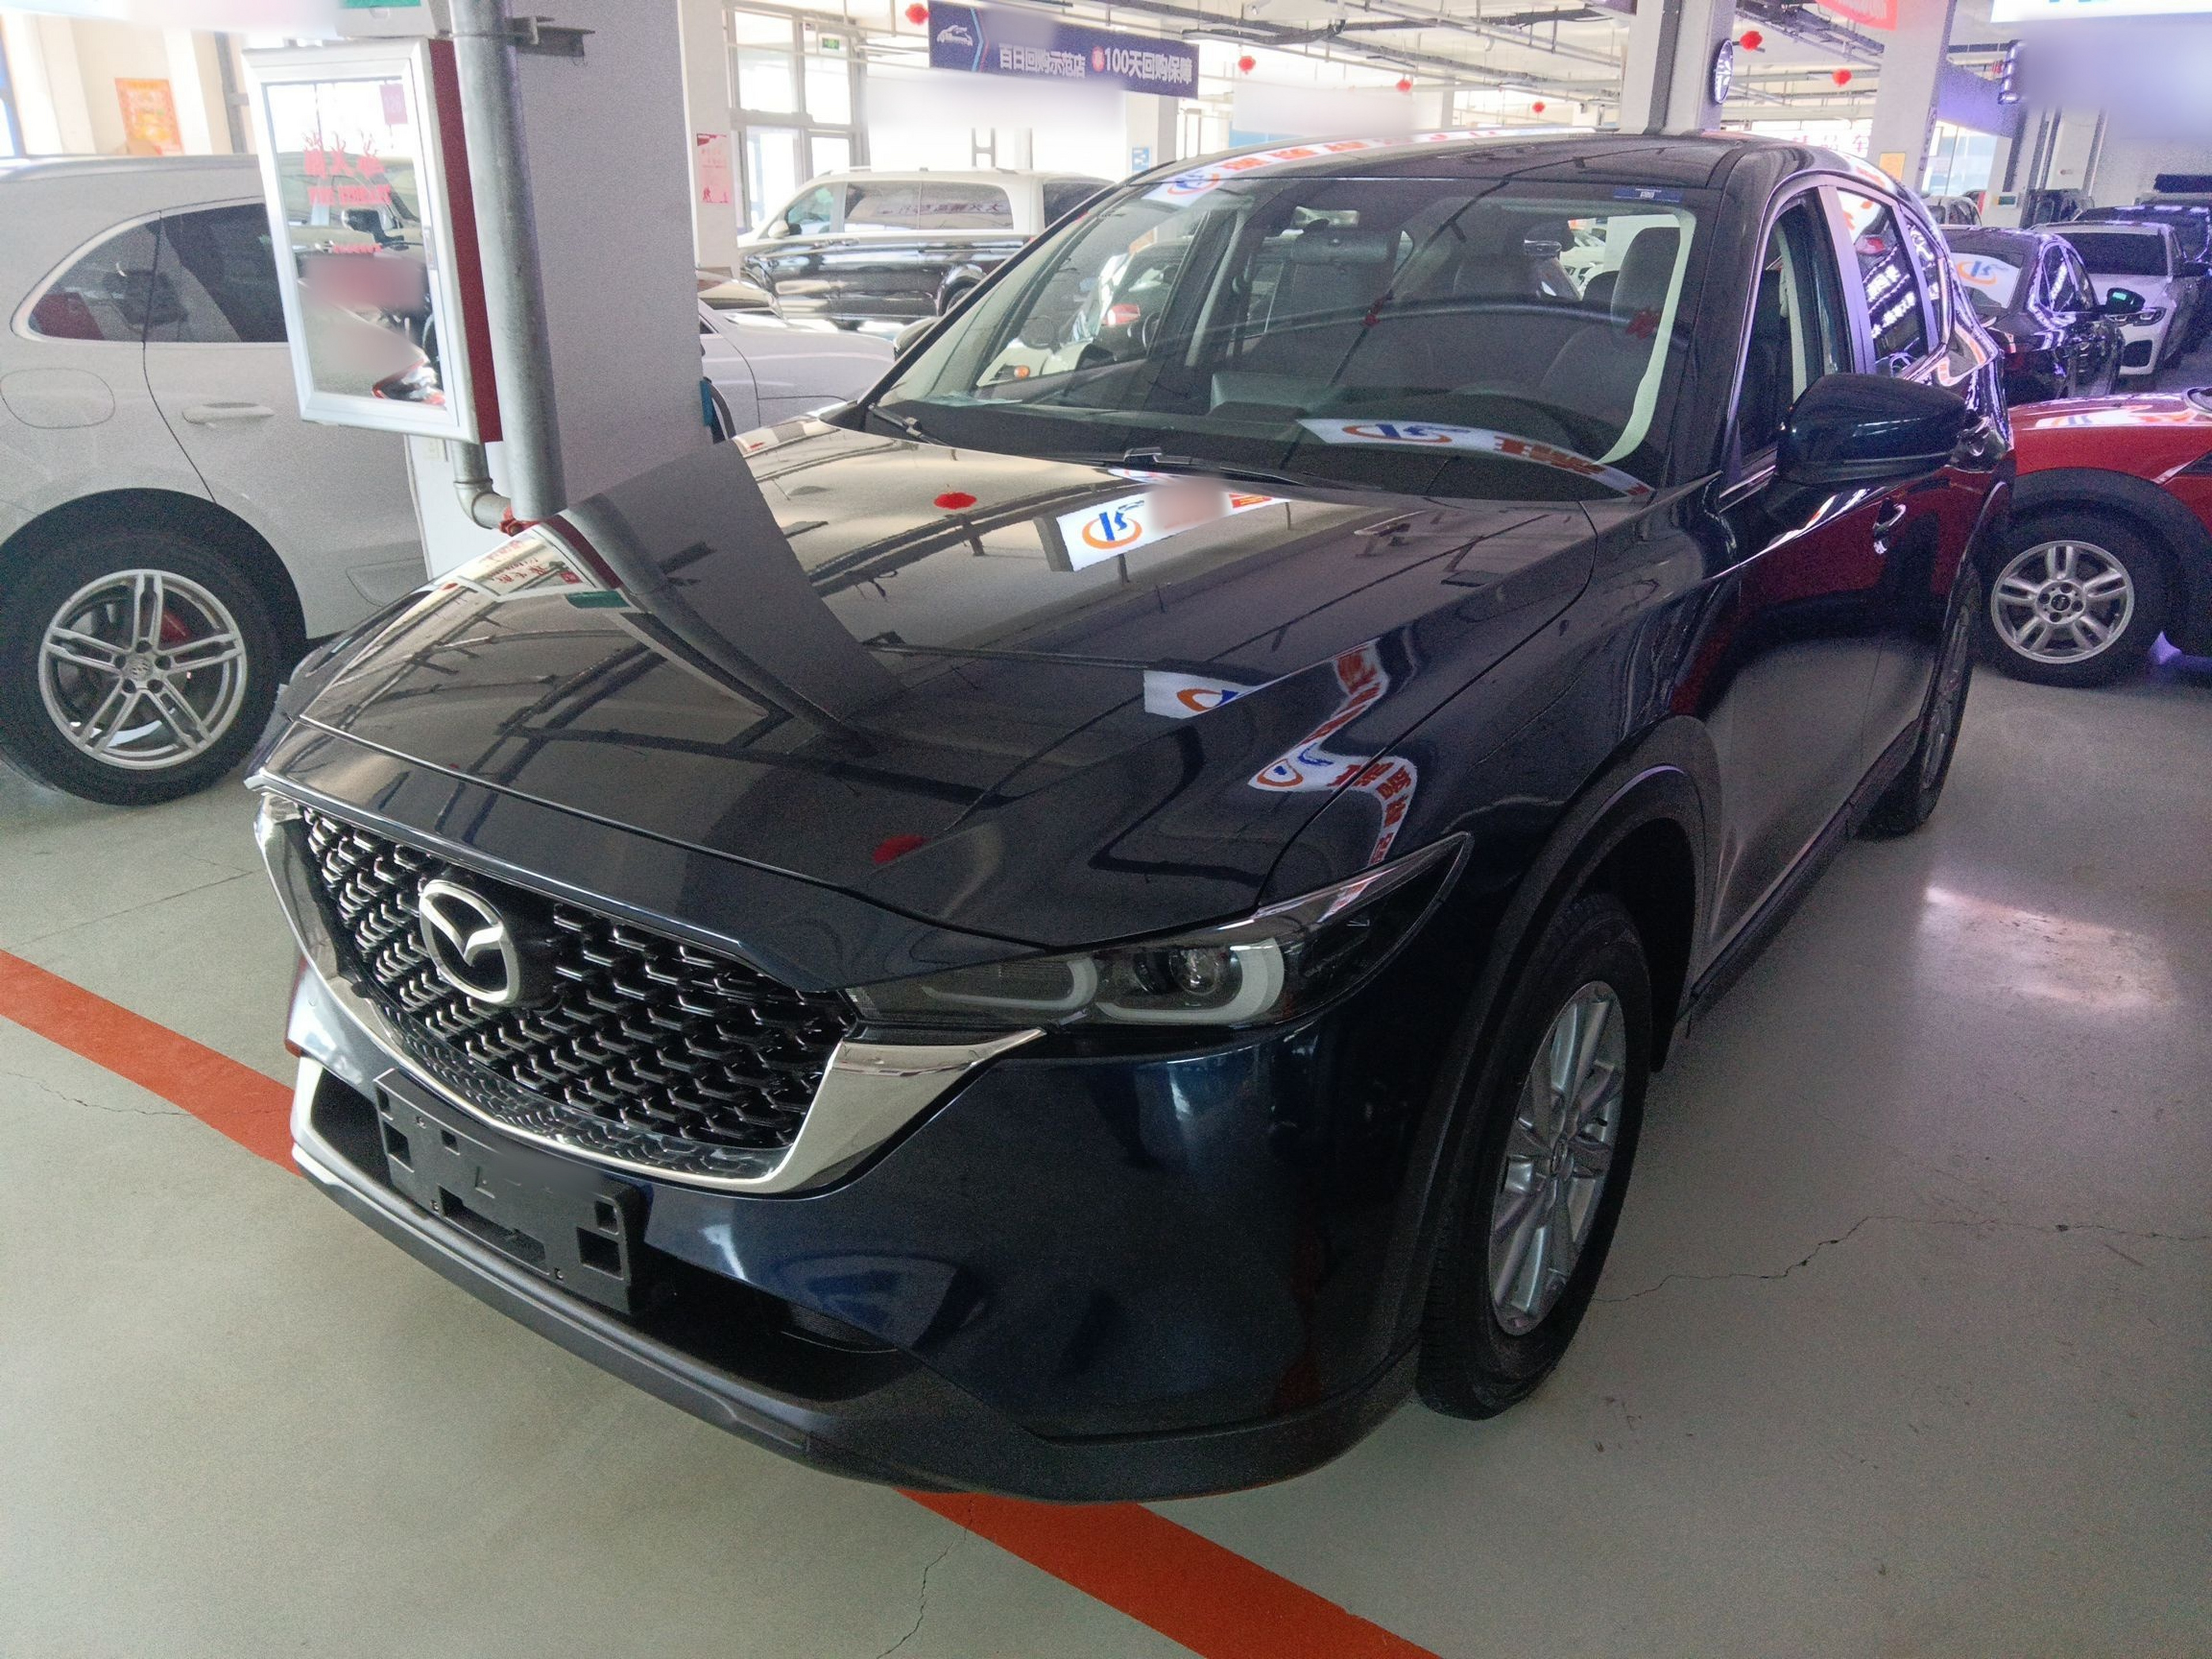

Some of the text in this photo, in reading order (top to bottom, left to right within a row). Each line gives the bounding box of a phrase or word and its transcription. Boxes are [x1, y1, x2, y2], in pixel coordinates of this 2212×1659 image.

[998, 44, 1086, 78] 百日回购示范店
